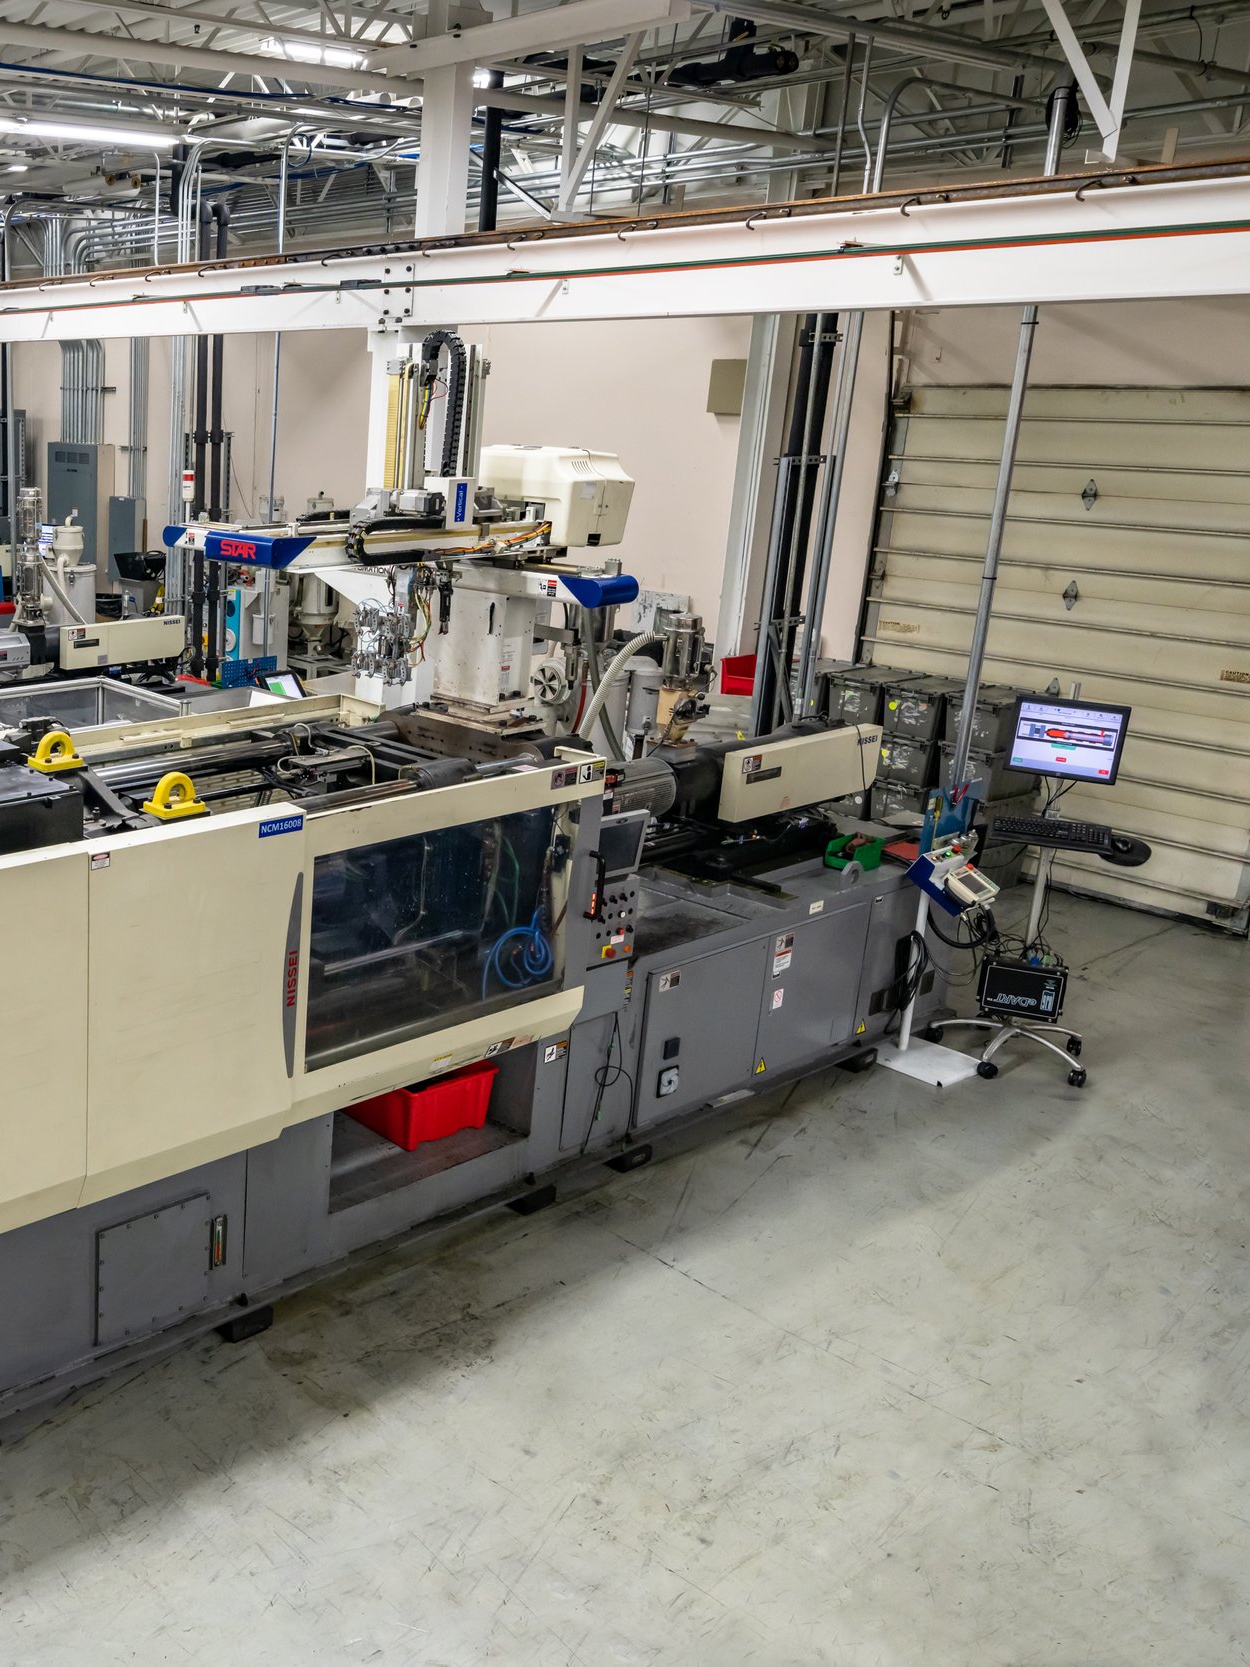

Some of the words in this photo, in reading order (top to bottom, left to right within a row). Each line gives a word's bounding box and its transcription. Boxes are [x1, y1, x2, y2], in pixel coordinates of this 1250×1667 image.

[220, 539, 256, 560] STAR
[261, 818, 302, 834] NCM16008
[286, 950, 298, 1007] NISSEI
